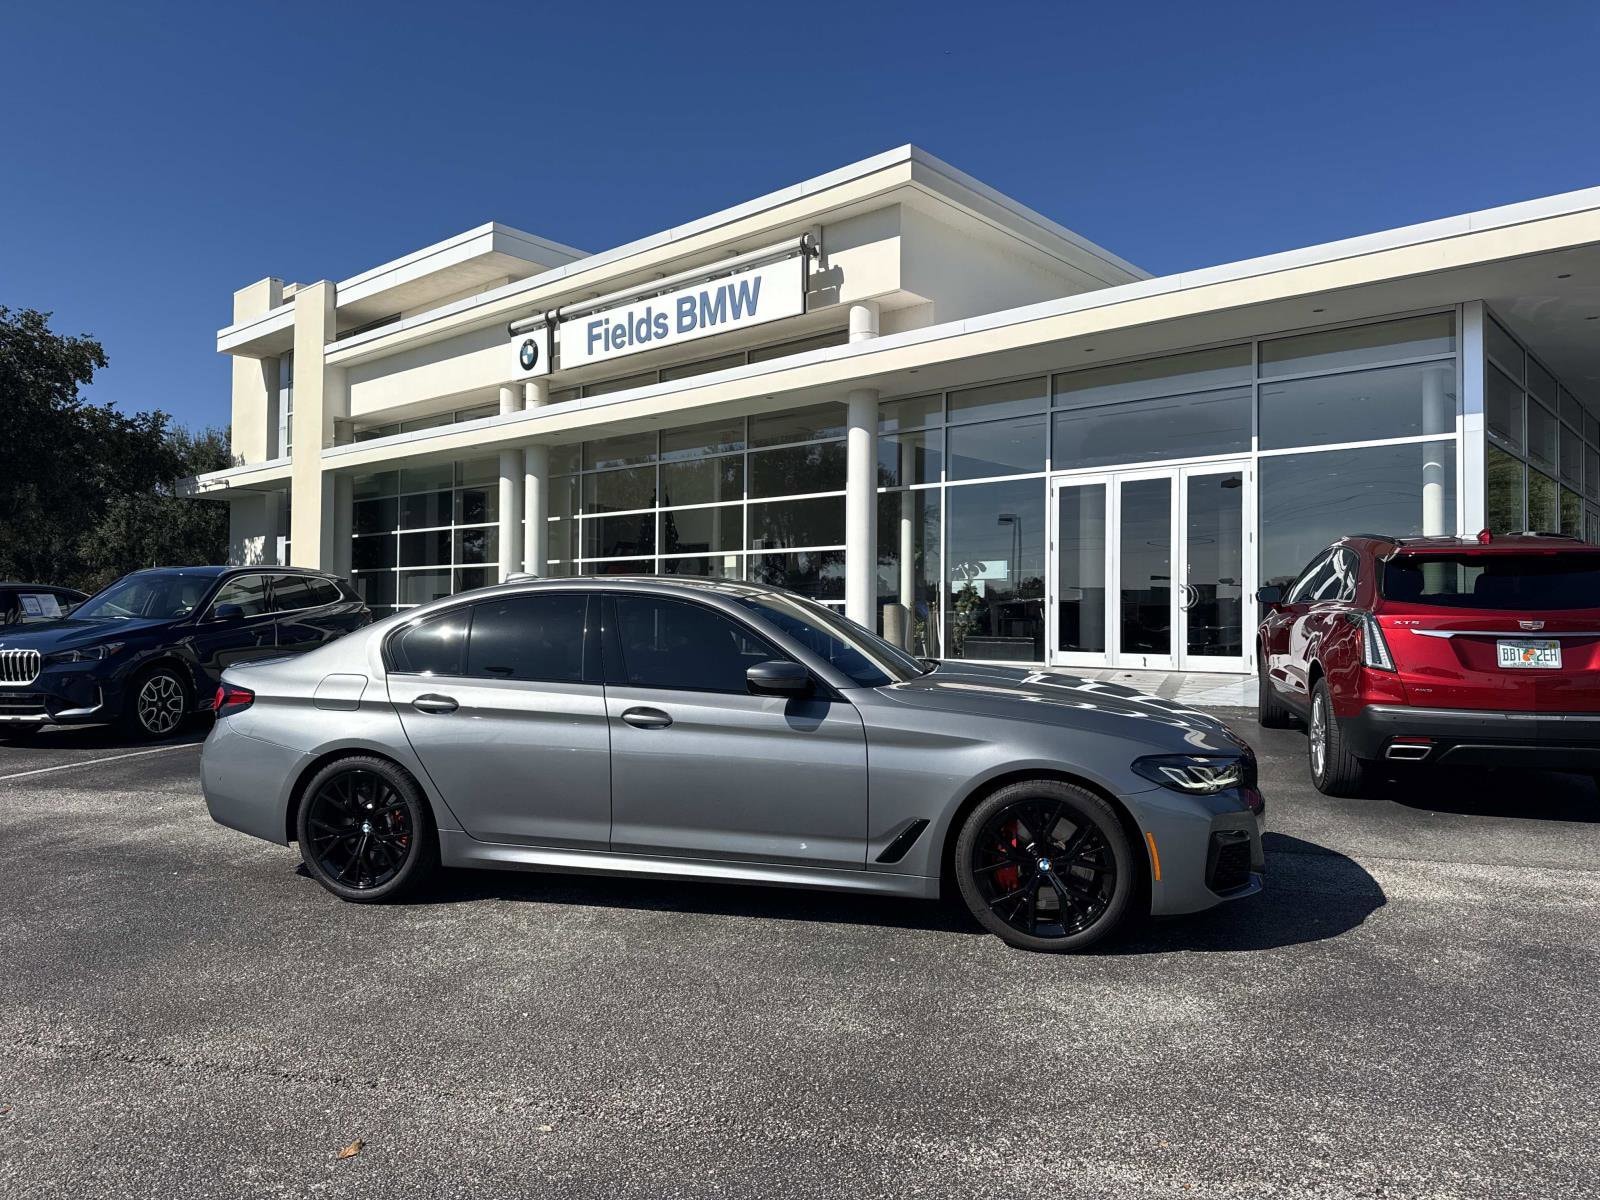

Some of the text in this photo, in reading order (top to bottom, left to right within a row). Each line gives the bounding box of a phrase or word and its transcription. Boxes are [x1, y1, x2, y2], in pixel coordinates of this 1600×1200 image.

[587, 276, 761, 355] Fields BMW
[1502, 648, 1521, 661] BB1
